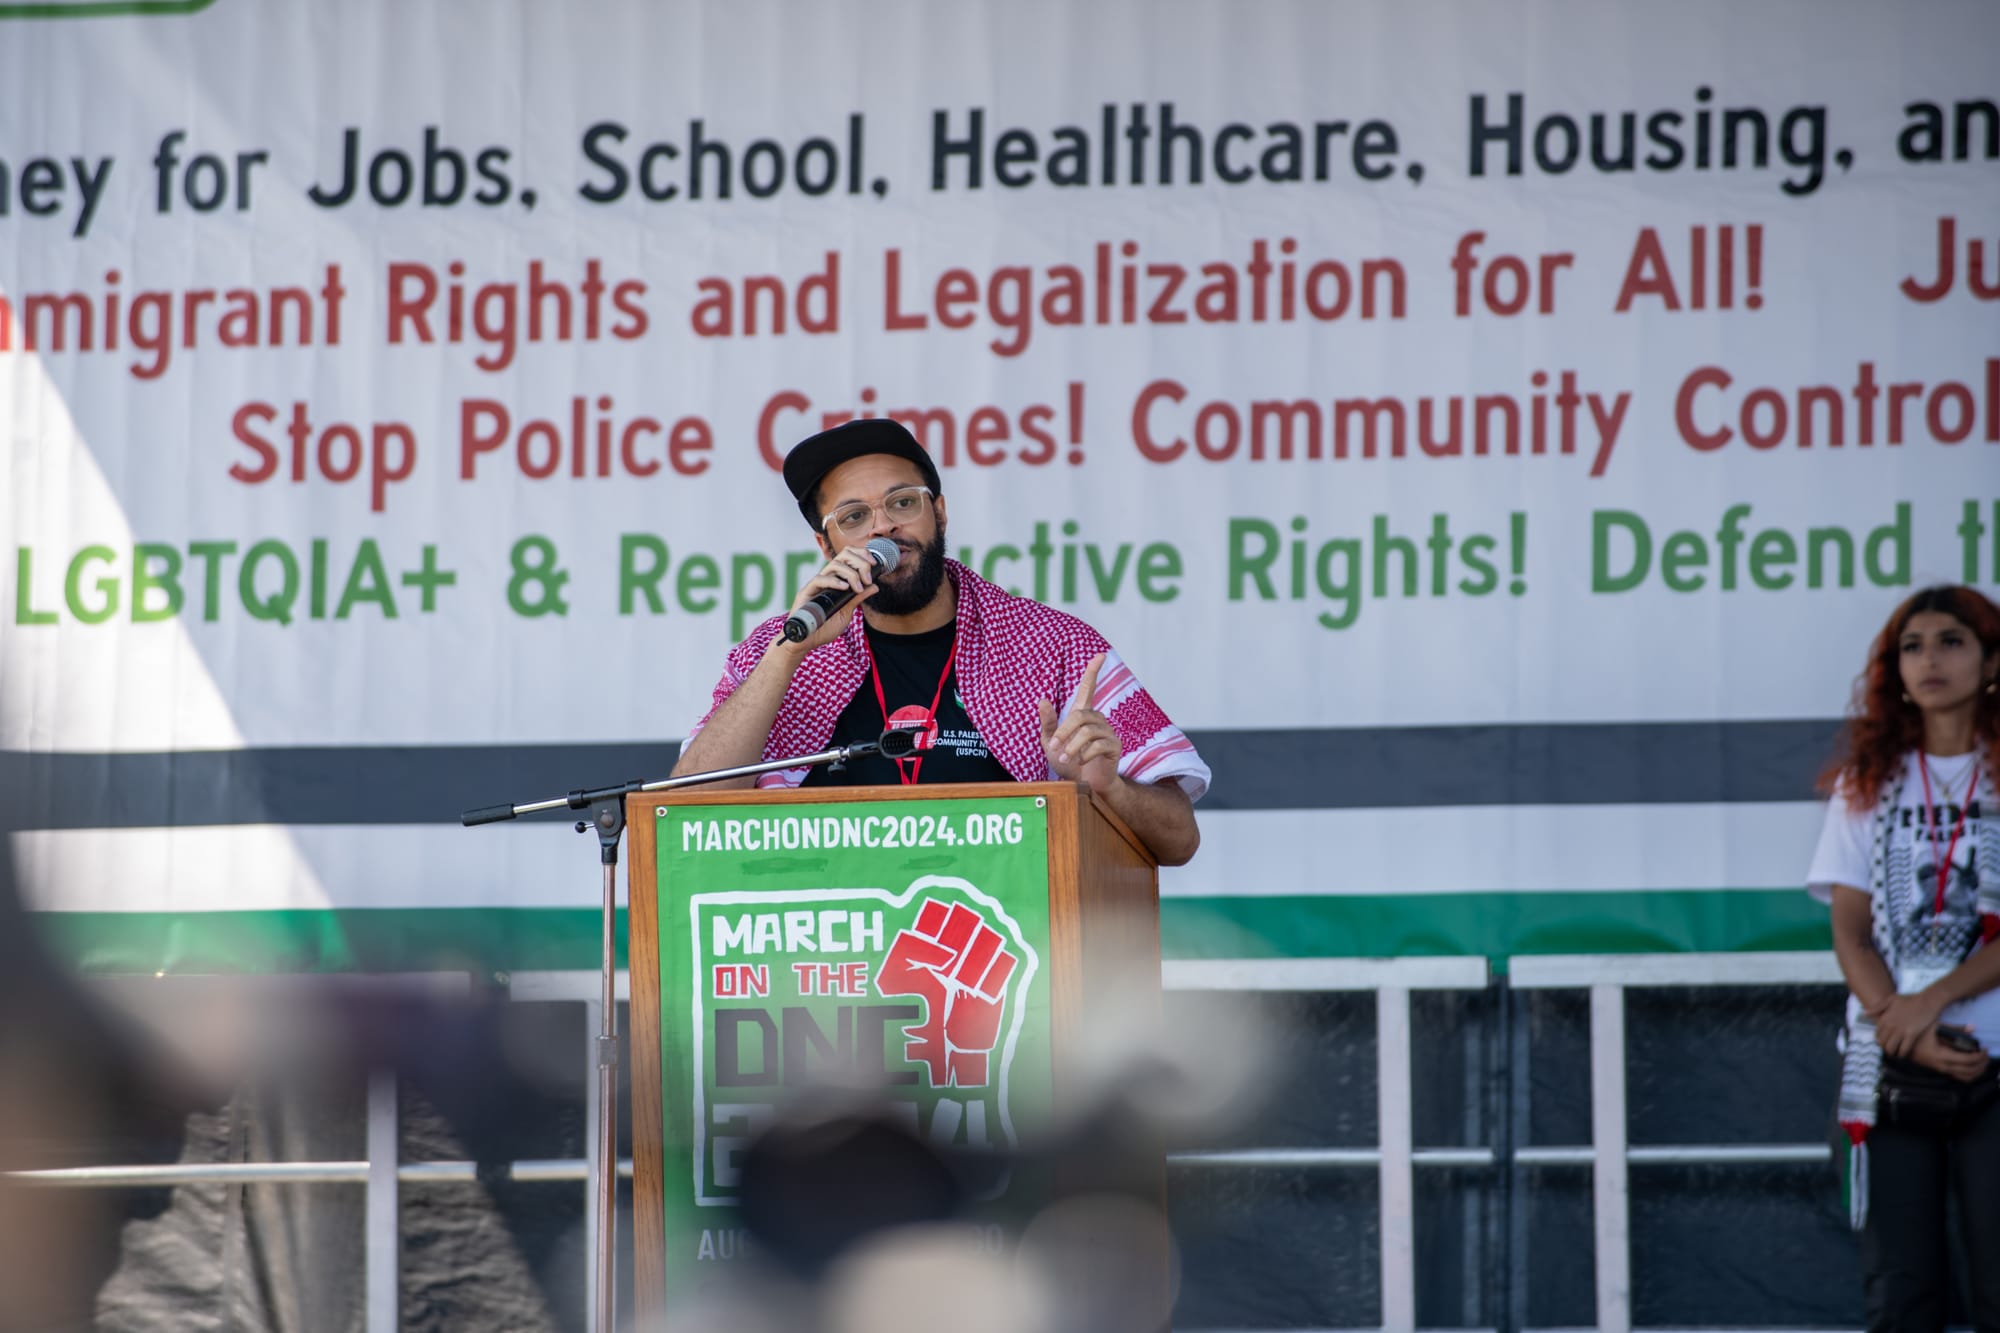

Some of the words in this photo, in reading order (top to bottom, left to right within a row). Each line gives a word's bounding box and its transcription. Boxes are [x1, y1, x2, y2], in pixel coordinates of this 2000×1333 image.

[0, 154, 115, 240] ey
[152, 130, 271, 215] for
[306, 126, 539, 213] Jobs,
[576, 111, 890, 208] School,
[930, 102, 1427, 193] Healthcare,
[1466, 84, 1857, 199] Housing,
[1893, 98, 2000, 167] an
[0, 262, 347, 382] migrant
[386, 258, 651, 375] Rights
[690, 249, 841, 340] and
[882, 236, 1409, 359] Legalization
[1450, 230, 1576, 319] for
[1612, 222, 1765, 314] All!
[227, 400, 419, 514] Stop
[459, 394, 714, 483] Police
[1130, 369, 1634, 479] Community
[1673, 355, 2000, 454] Control
[14, 536, 458, 628] LGBTQIA+
[505, 532, 571, 620] &
[1226, 510, 1529, 632] Rights!
[1589, 500, 1915, 597] Defend
[933, 737, 978, 748] OMMUNITY
[943, 730, 957, 738] U.S.
[956, 747, 988, 759] (USPCN)
[682, 812, 1023, 851] MARCHONDNC2024.ORG
[712, 910, 884, 956] MARCH
[713, 964, 770, 998] ON
[791, 961, 868, 997] THE
[714, 1004, 920, 1088] DNC
